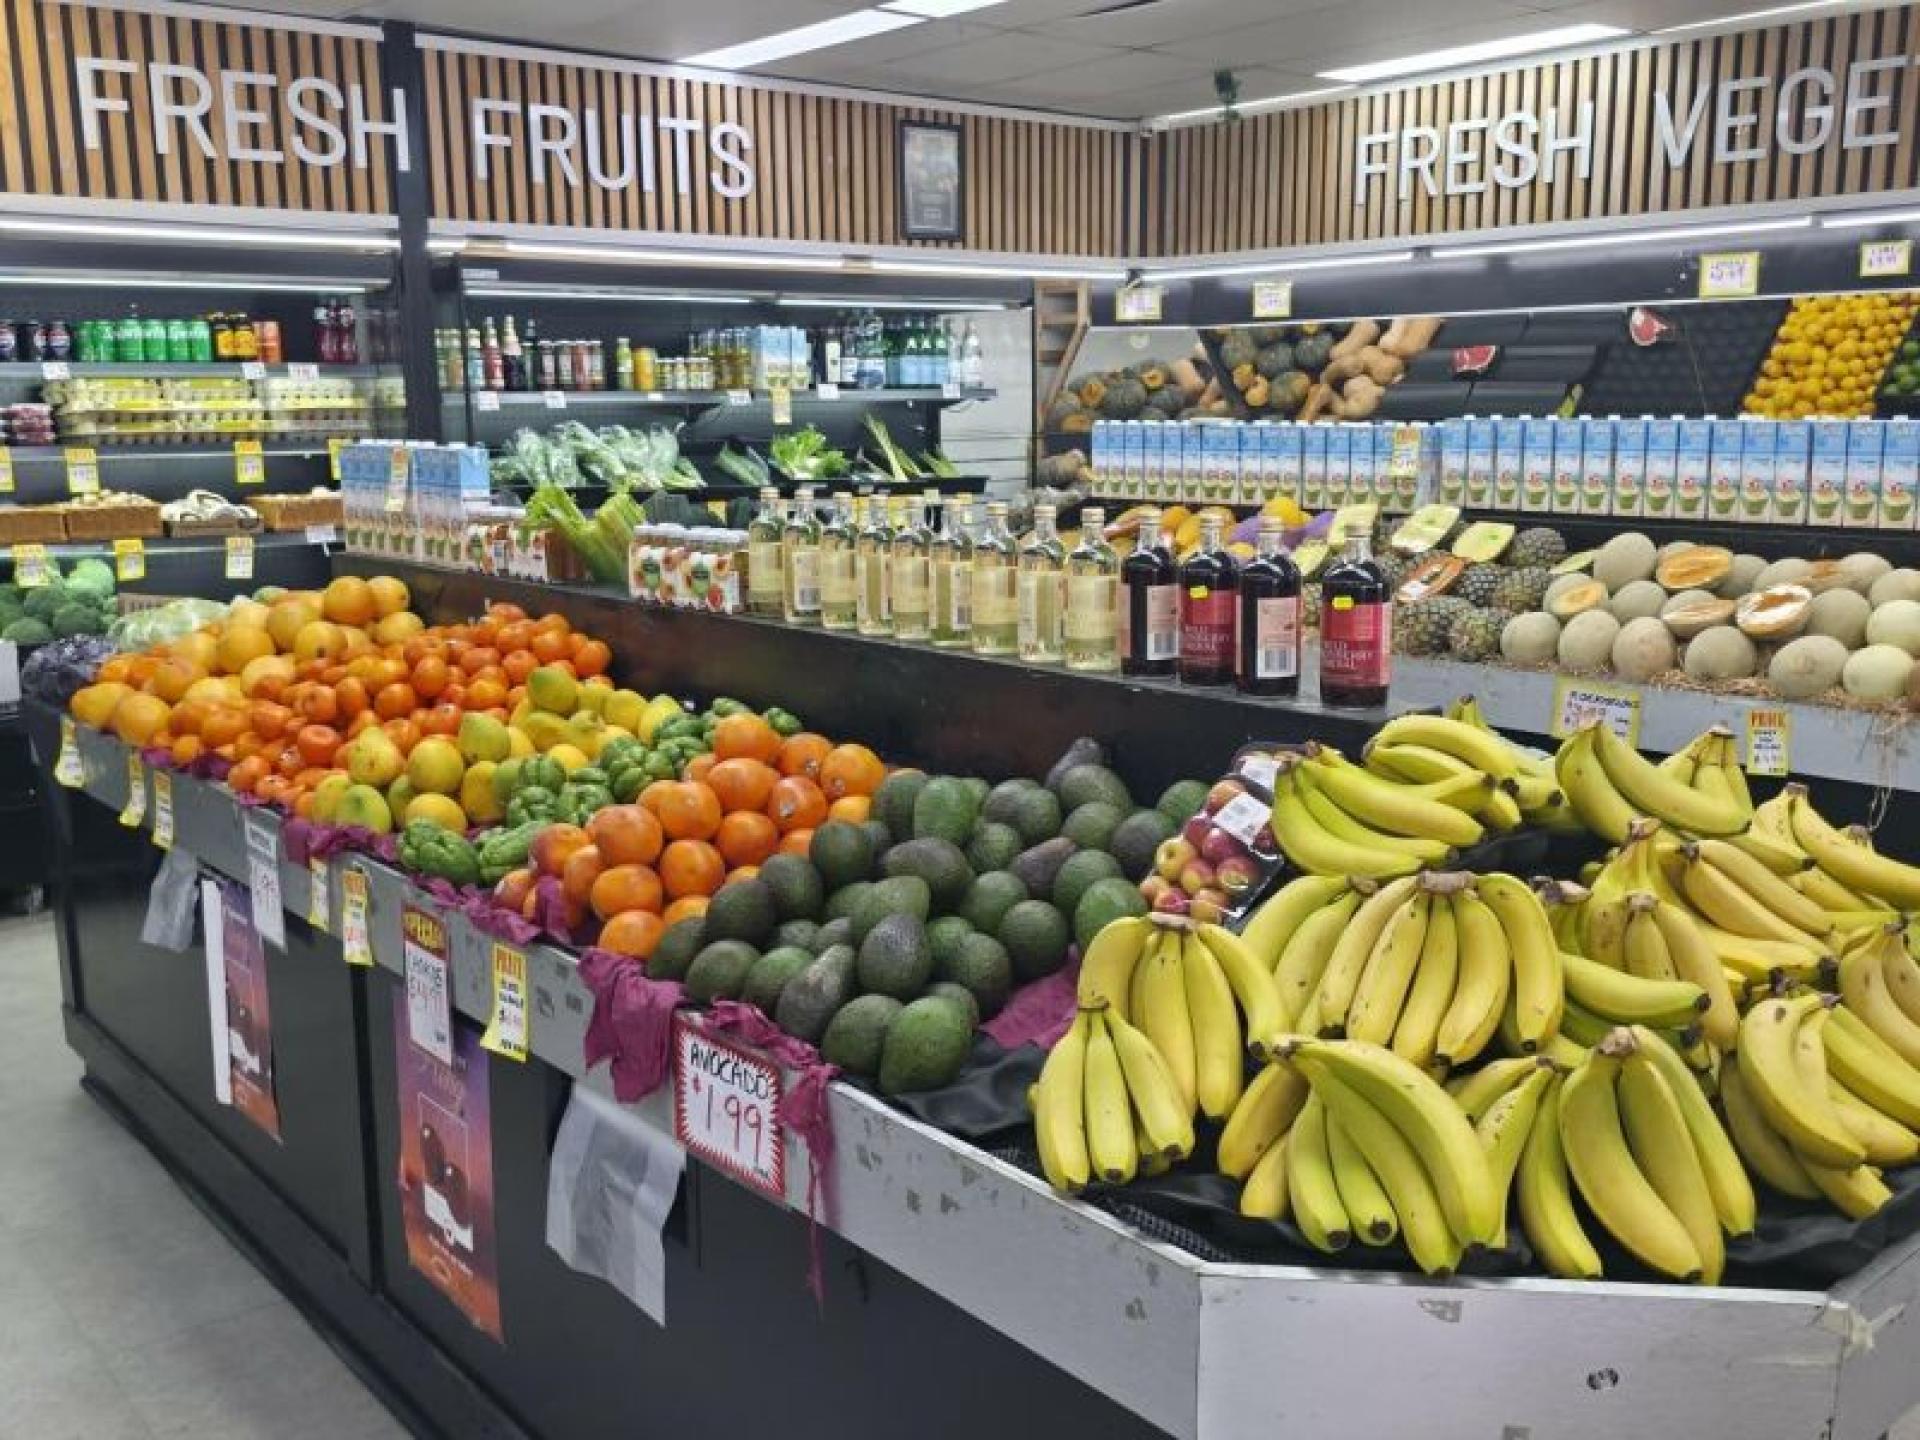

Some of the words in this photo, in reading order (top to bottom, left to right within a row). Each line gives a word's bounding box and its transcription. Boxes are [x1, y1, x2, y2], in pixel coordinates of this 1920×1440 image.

[75, 57, 410, 172] FRESH
[472, 97, 754, 199] FRUITS
[1355, 99, 1594, 205] FRESH
[1653, 54, 1920, 169] VEGE
[690, 1043, 769, 1100] AVOCADO
